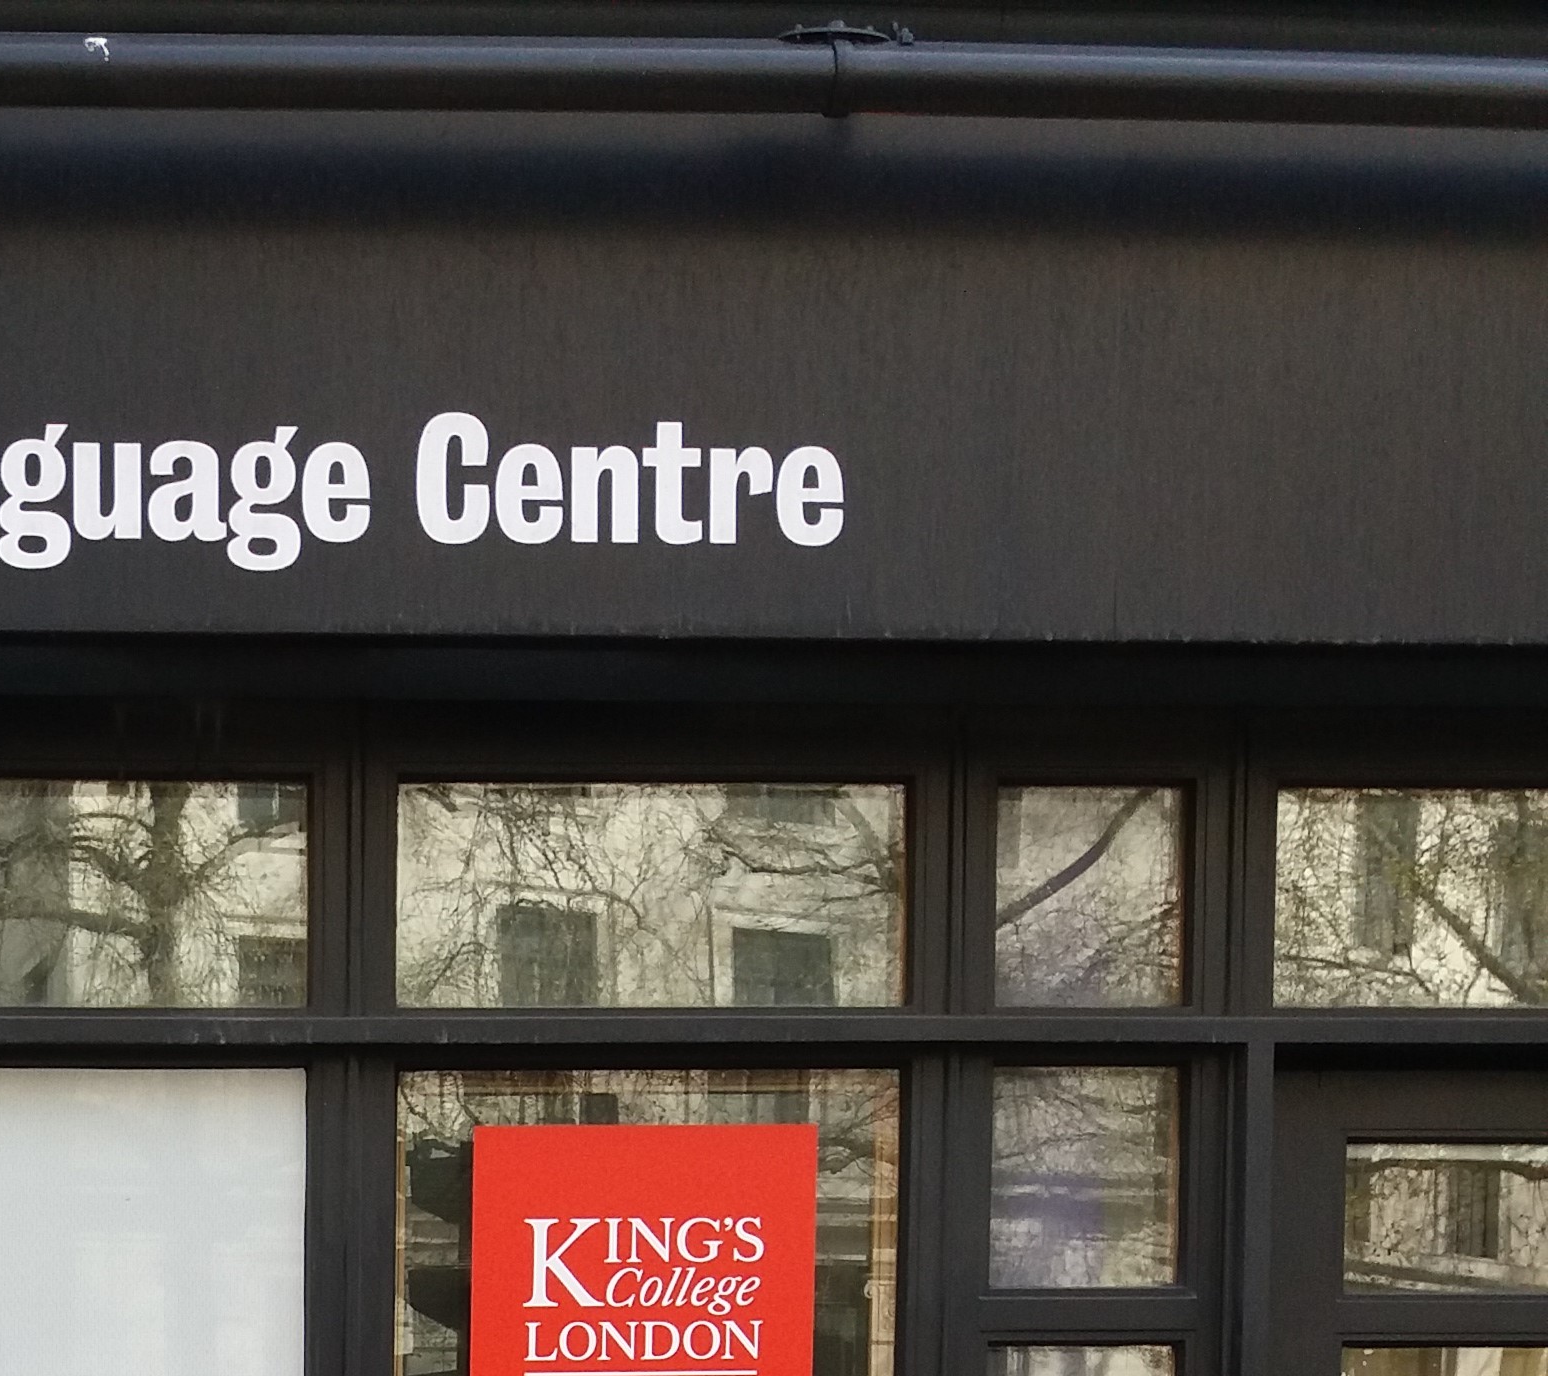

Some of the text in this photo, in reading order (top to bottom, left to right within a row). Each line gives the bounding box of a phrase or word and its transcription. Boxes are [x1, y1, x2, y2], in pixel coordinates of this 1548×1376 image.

[413, 411, 845, 548] Centre
[522, 1217, 765, 1316] KING'S College
[523, 1320, 764, 1361] LONDON
